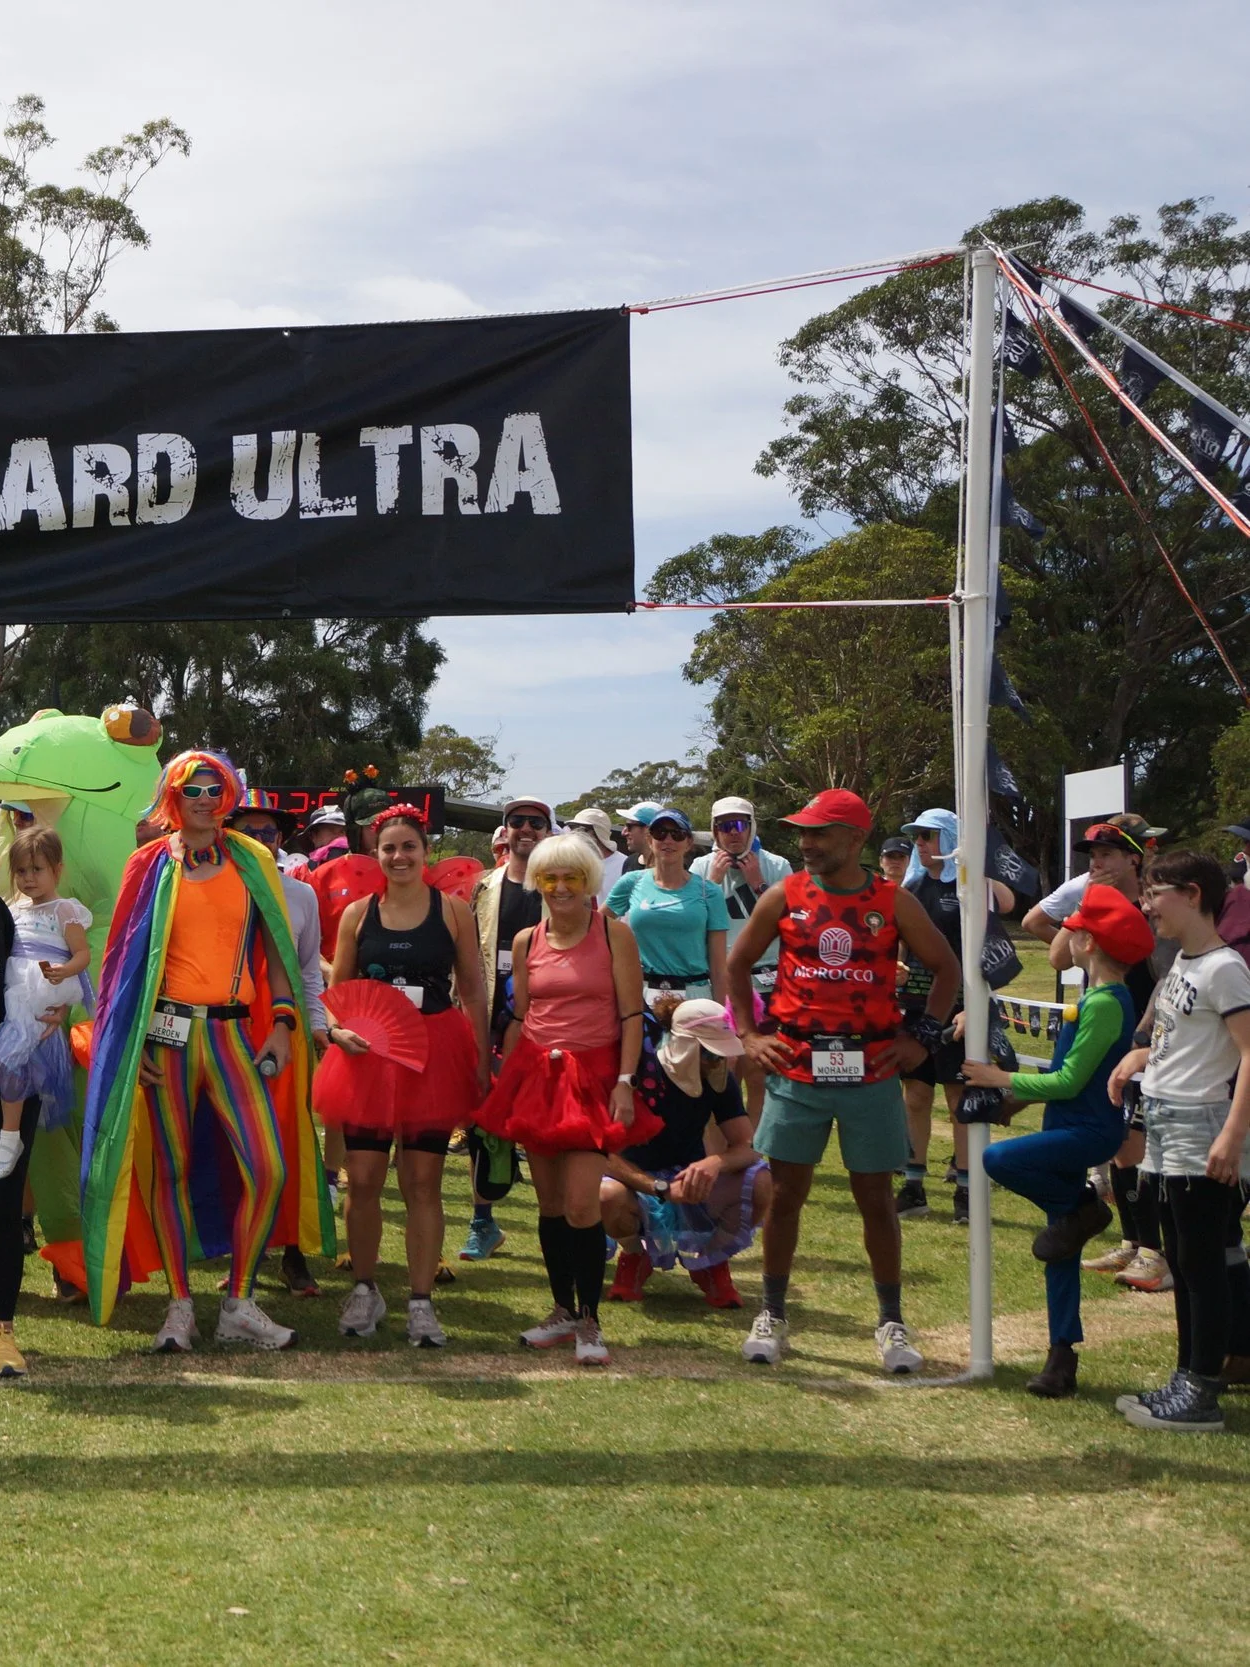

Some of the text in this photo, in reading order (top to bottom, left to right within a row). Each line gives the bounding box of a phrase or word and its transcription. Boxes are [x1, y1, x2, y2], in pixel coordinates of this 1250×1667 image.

[229, 412, 561, 519] ULTRA
[794, 966, 873, 982] MOROCCO
[163, 1015, 174, 1028] 14
[152, 1026, 181, 1039] JEROEN
[830, 1052, 844, 1066] 53
[817, 1066, 860, 1075] MOHAMED
